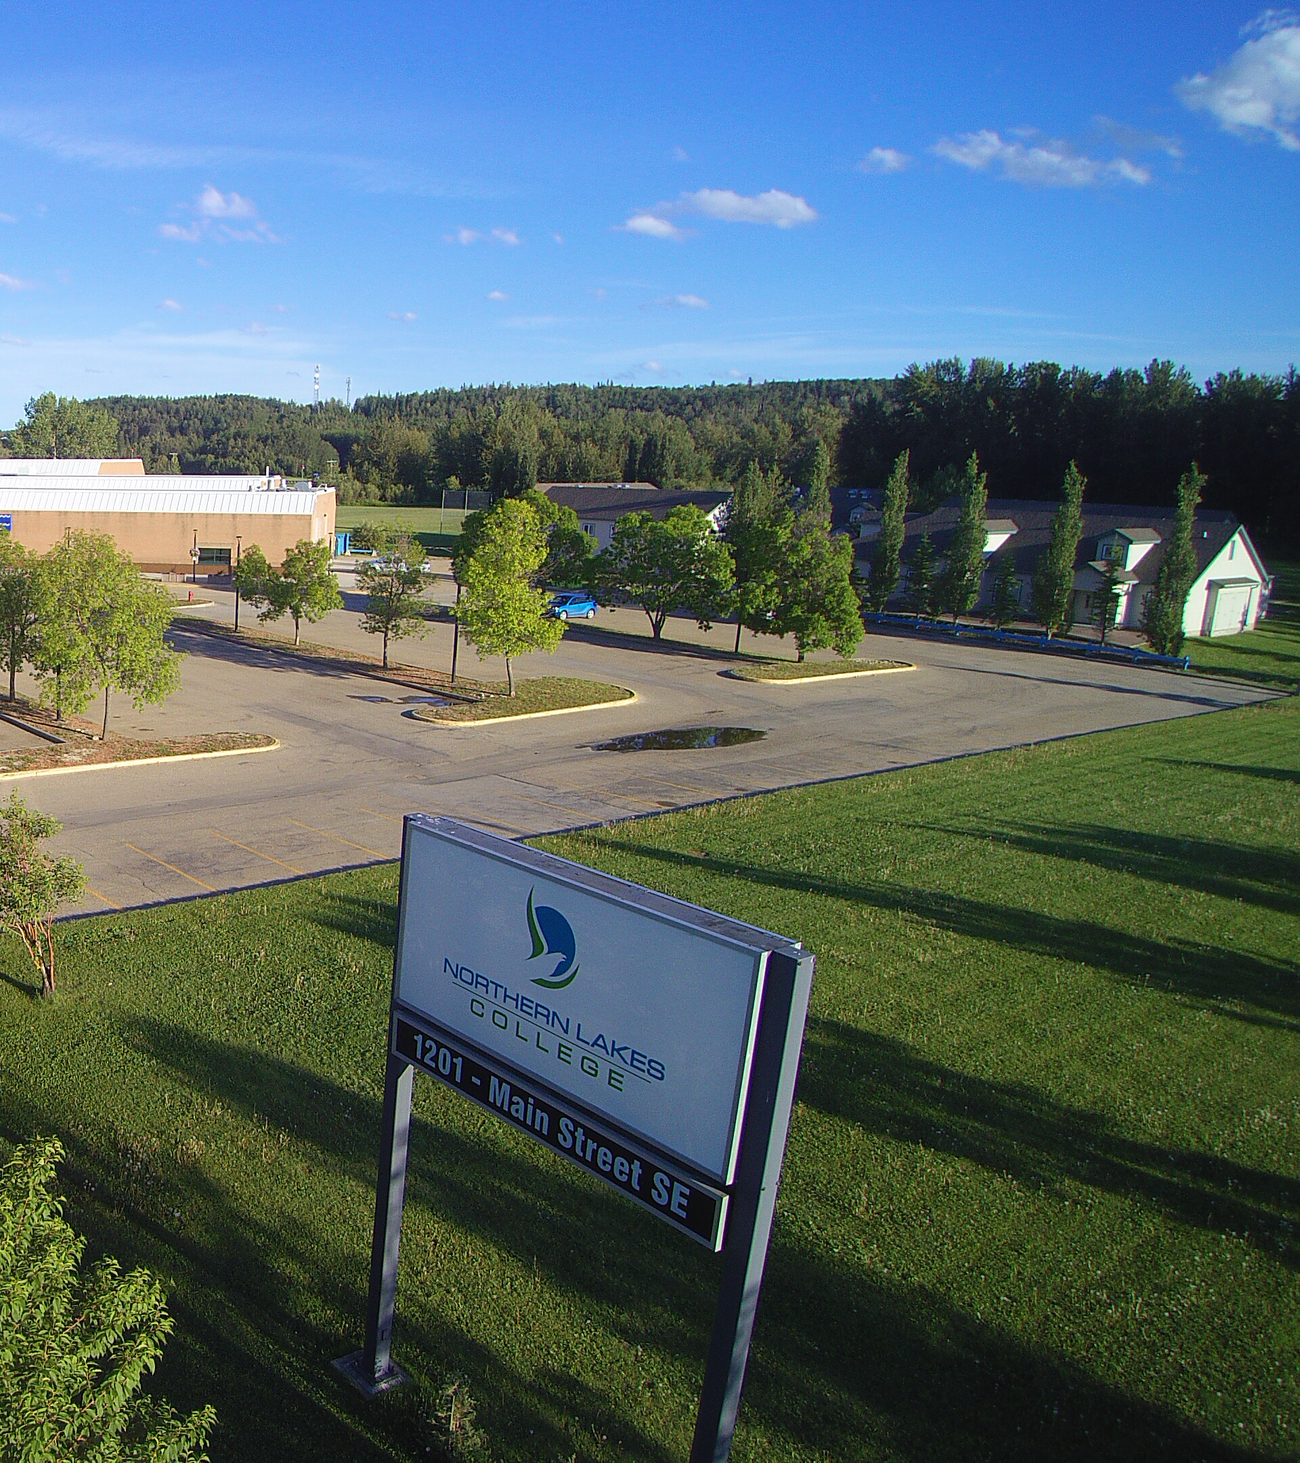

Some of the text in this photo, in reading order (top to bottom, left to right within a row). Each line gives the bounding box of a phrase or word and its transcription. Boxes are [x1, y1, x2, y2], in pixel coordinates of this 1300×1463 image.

[443, 957, 666, 1081] NORTHERN LAKES
[470, 998, 625, 1092] COLLEGE
[413, 1033, 691, 1219] 1201 - Main Street SE
